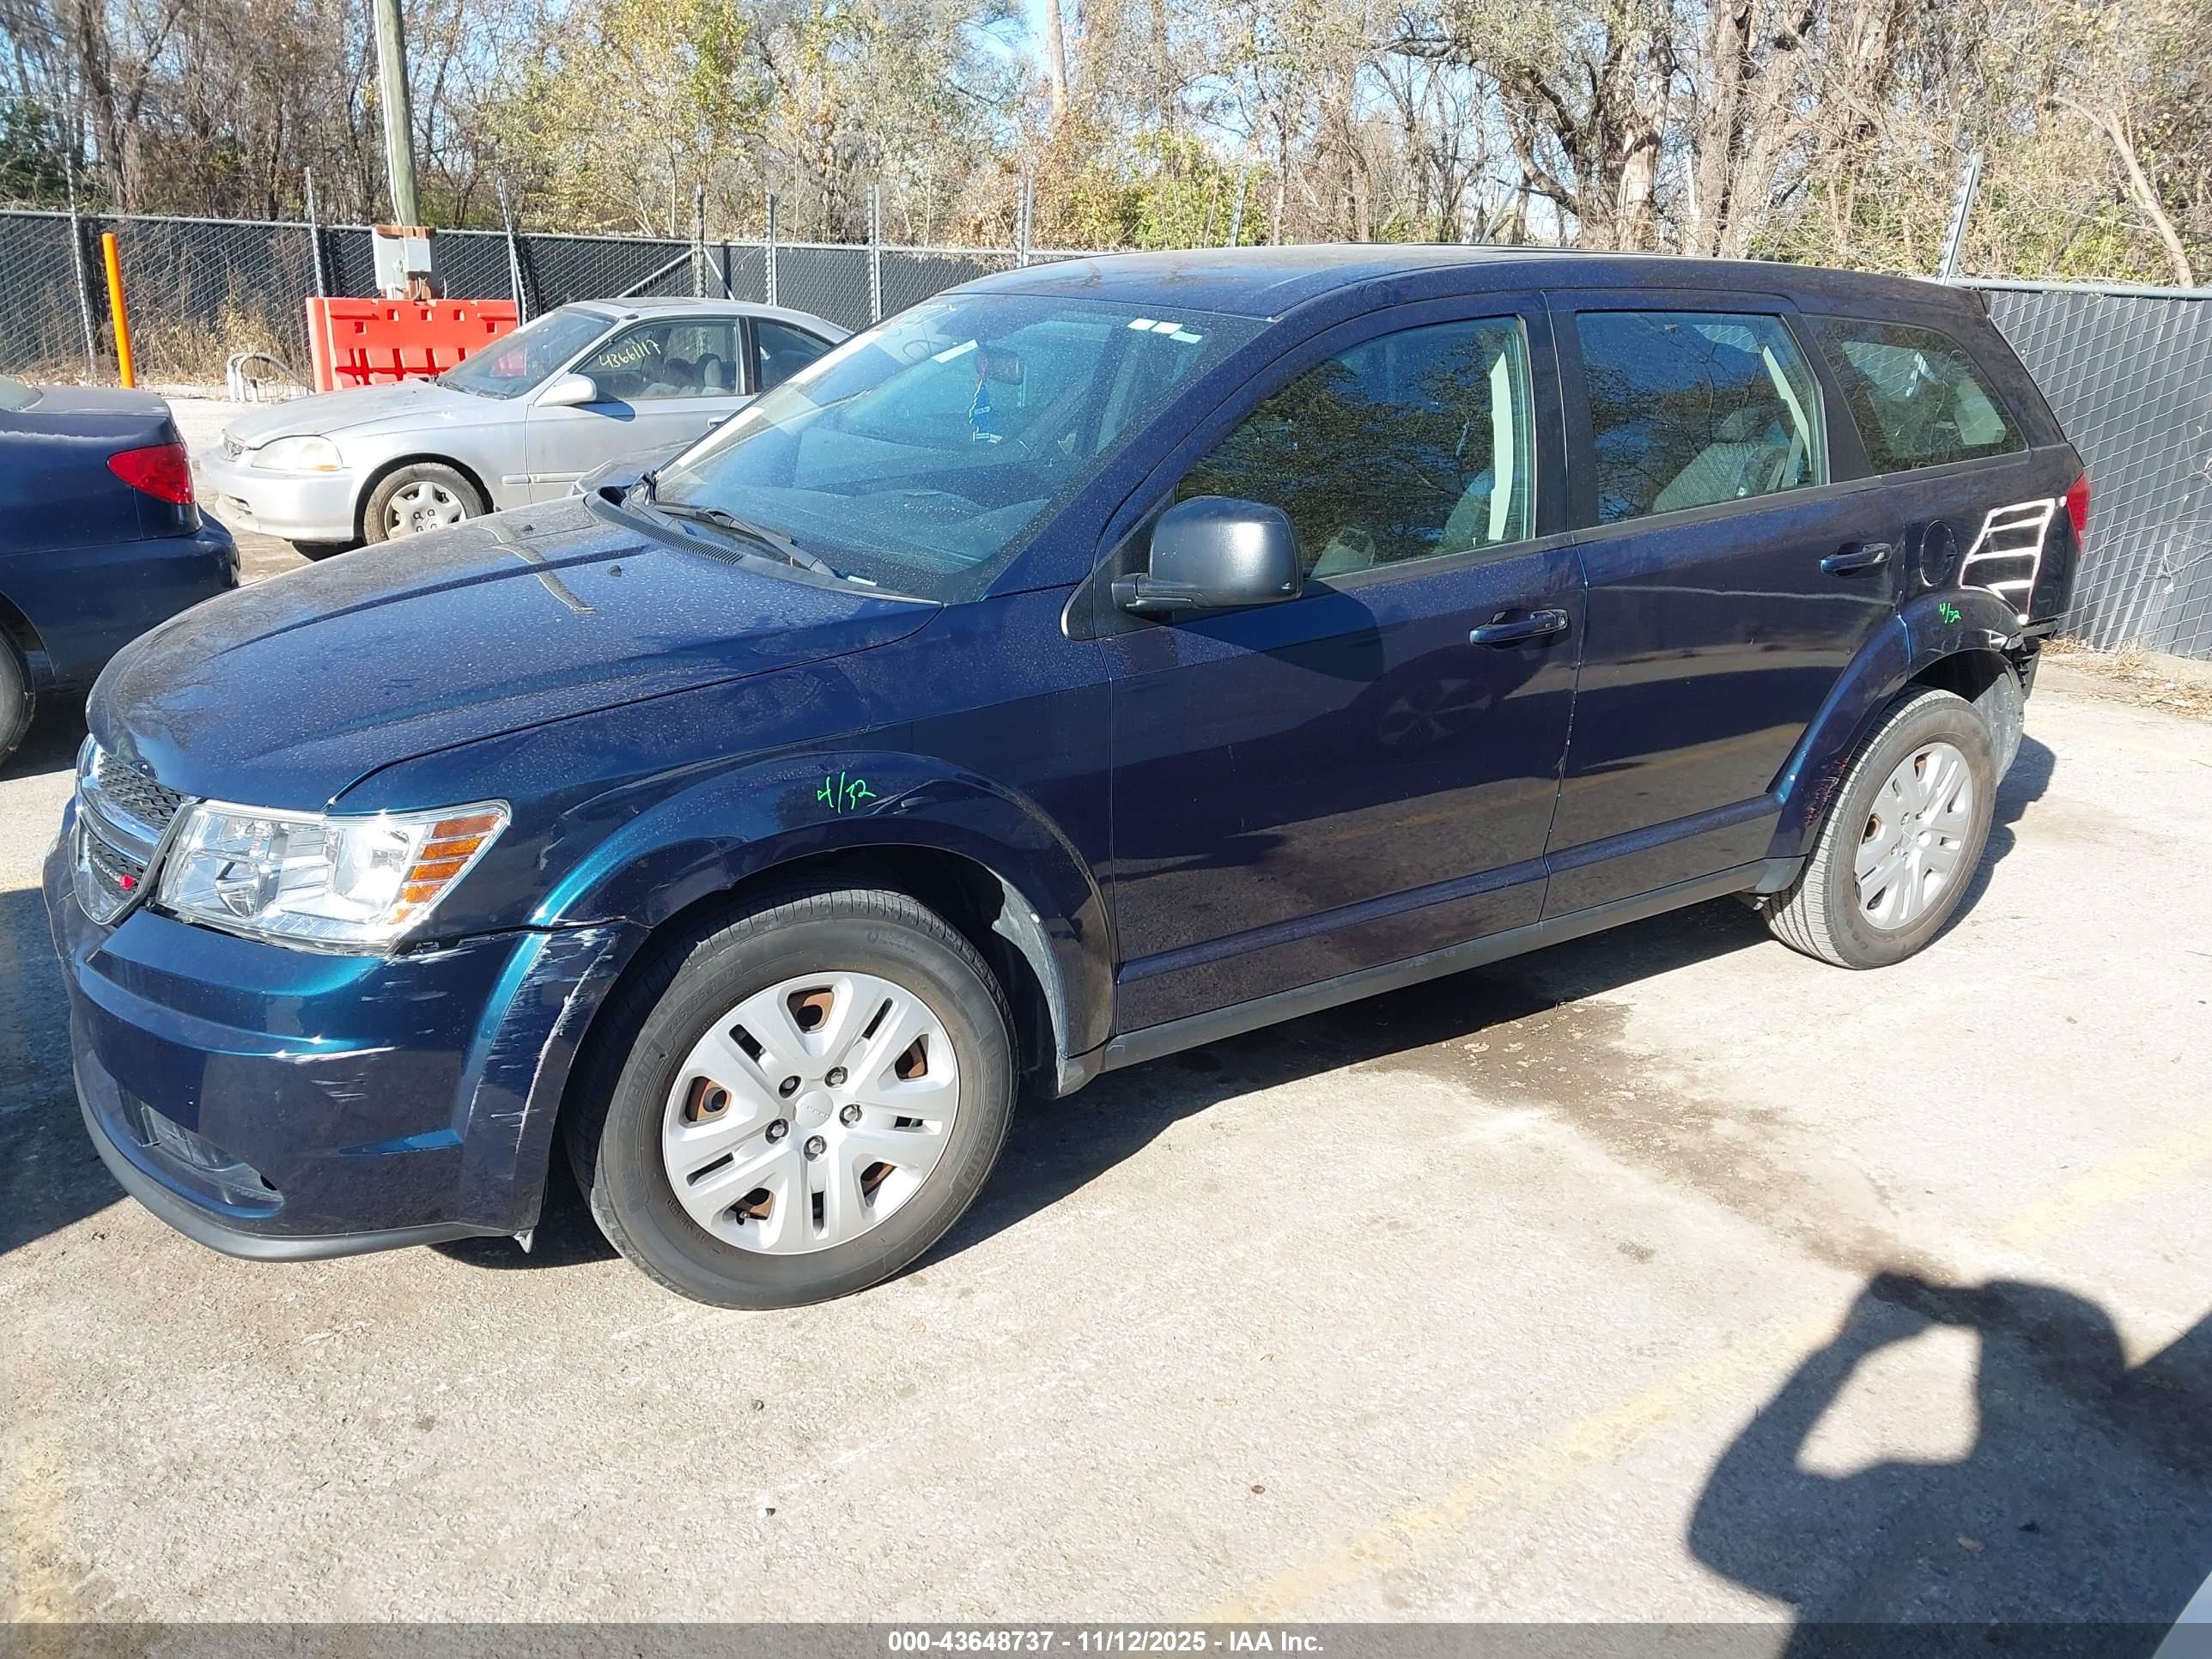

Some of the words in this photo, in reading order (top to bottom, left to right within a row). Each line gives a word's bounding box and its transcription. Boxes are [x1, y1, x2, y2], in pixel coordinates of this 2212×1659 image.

[599, 338, 661, 368] 43661117
[1939, 602, 1962, 624] 4/32
[817, 771, 877, 814] 4/32
